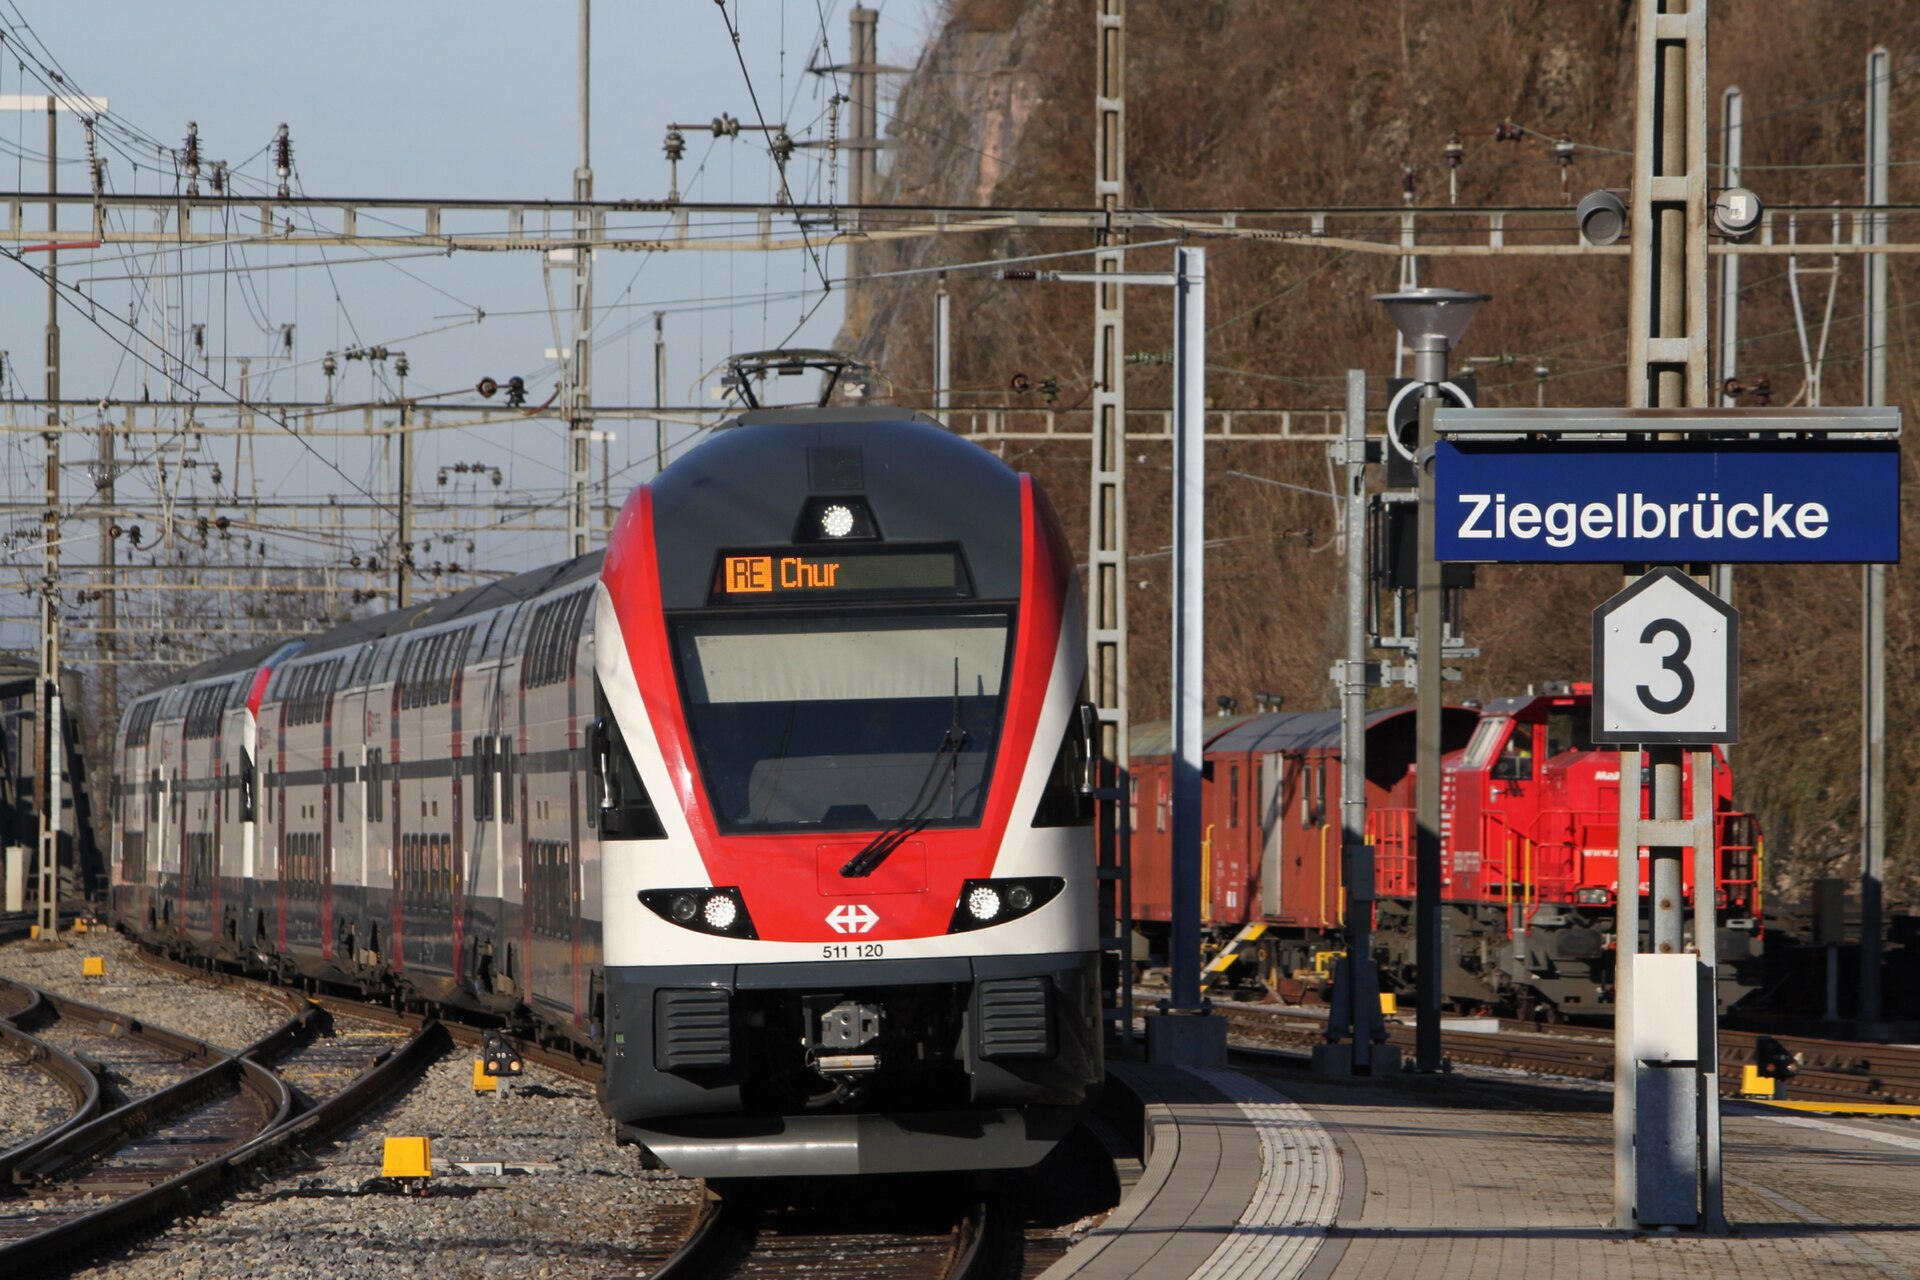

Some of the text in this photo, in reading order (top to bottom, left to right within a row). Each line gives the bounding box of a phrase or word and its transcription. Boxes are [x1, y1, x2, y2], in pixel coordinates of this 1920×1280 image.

[1458, 493, 1829, 547] Ziegelbrücke
[732, 557, 839, 588] RE Chur
[1636, 617, 1695, 715] 3
[822, 943, 884, 959] 511 120
